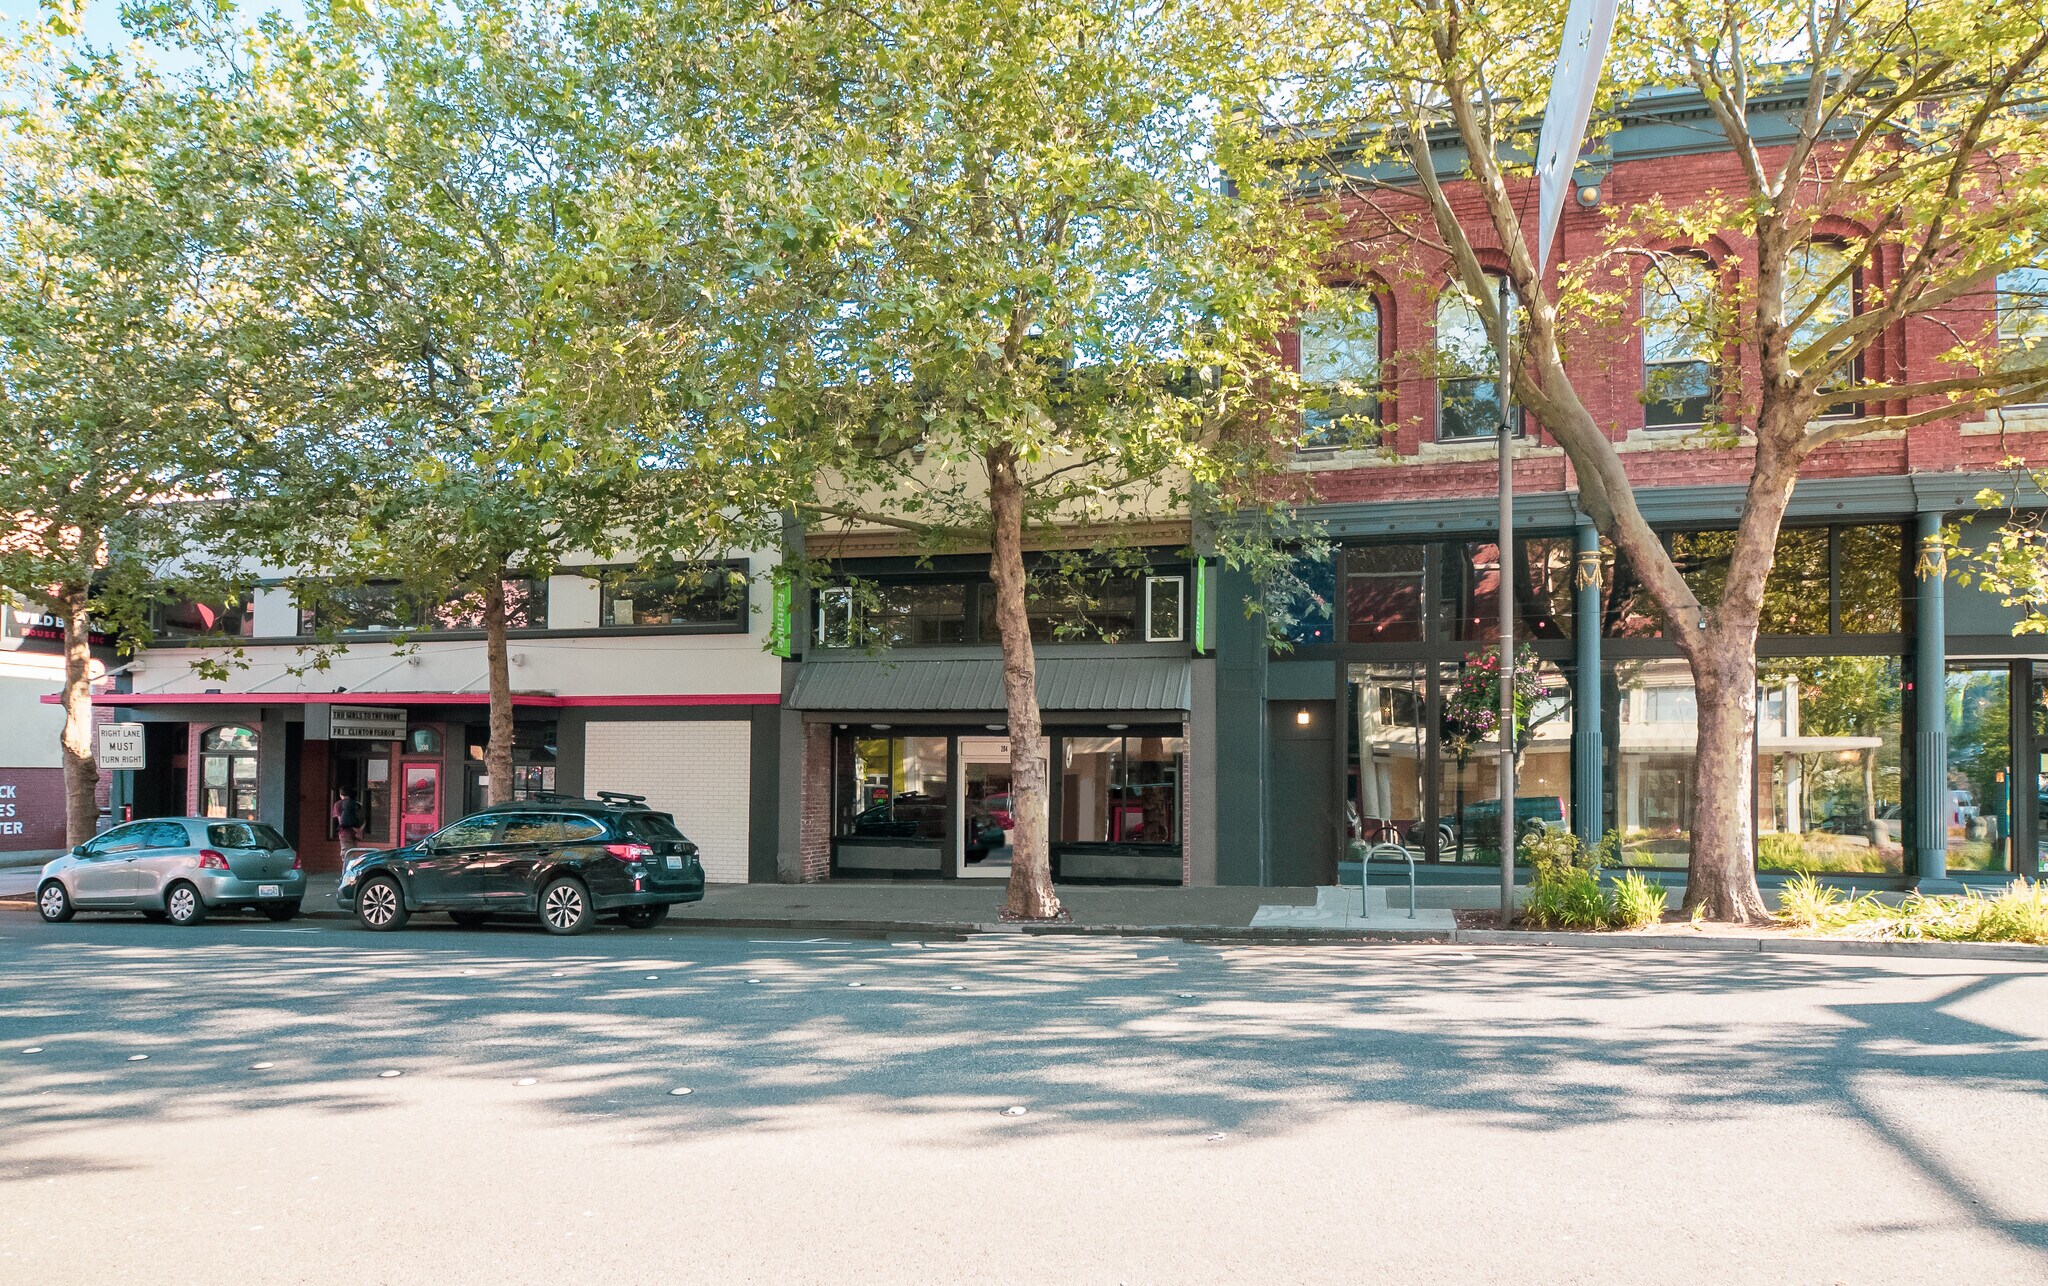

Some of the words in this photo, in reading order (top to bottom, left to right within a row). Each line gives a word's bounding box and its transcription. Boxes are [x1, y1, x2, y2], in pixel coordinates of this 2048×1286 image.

[22, 628, 56, 639] HOUSE
[332, 711, 345, 719] THU
[101, 730, 121, 738] RIGHT
[123, 730, 141, 738] LANE
[333, 727, 344, 735] FRI
[109, 743, 133, 751] MUST
[102, 755, 120, 763] TURN
[122, 755, 142, 763] RIGHT
